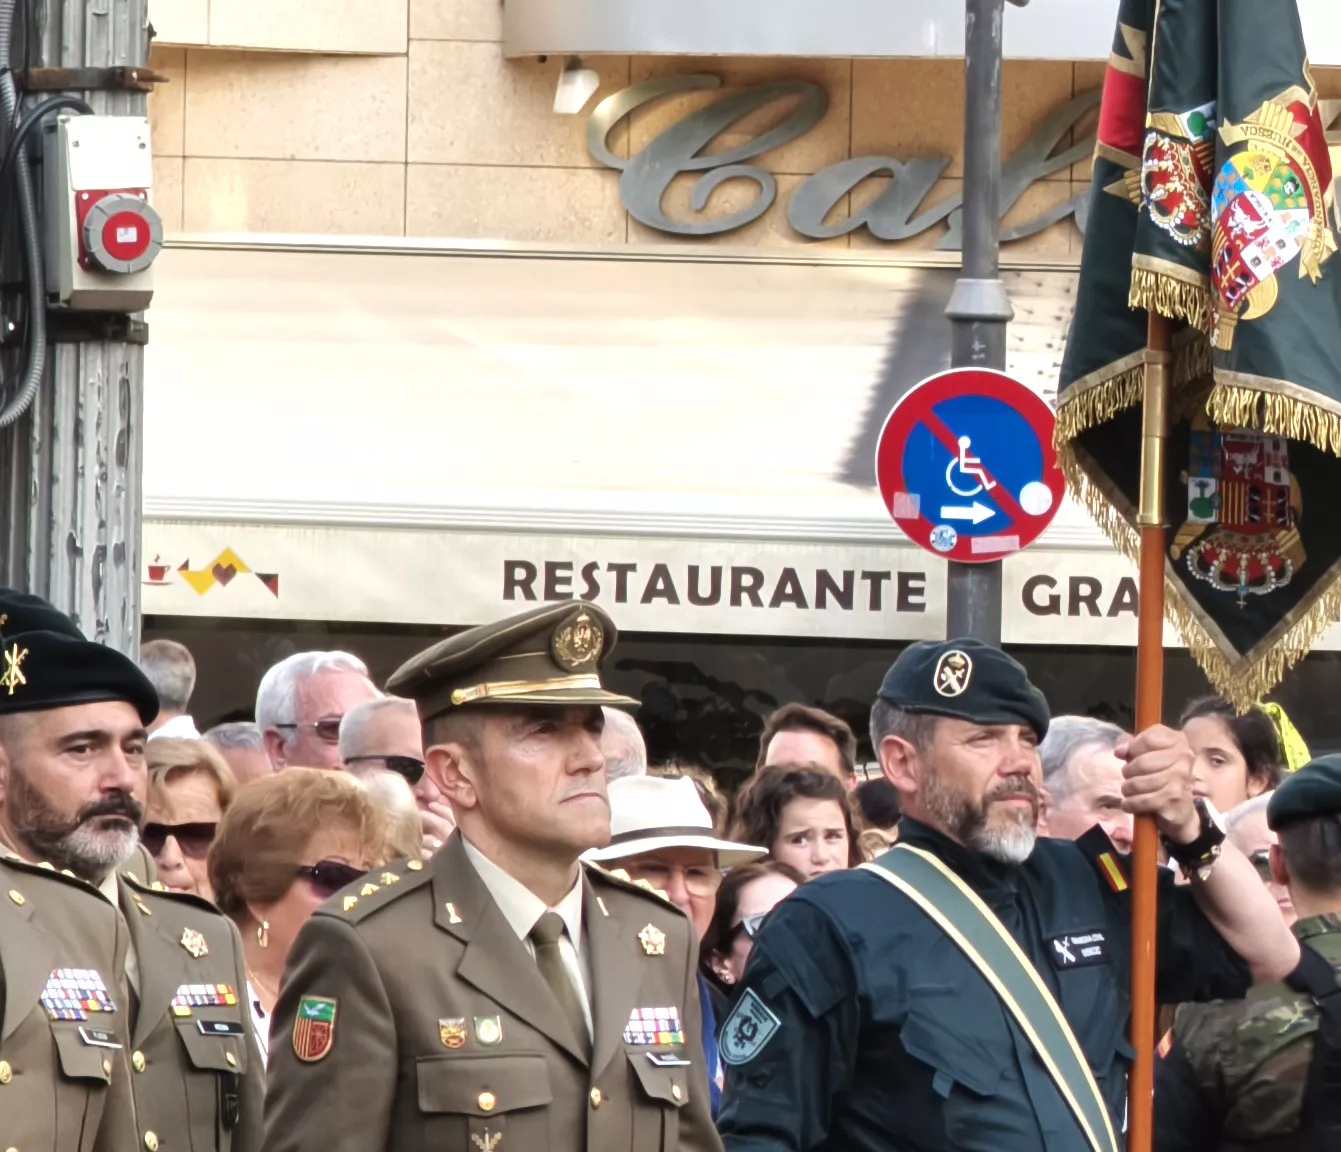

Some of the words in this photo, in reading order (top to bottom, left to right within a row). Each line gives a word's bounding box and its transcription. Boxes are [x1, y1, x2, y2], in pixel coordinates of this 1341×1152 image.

[1240, 125, 1293, 148] HUESCA
[502, 558, 928, 613] RESTAURANTE
[1021, 573, 1139, 617] GRA
